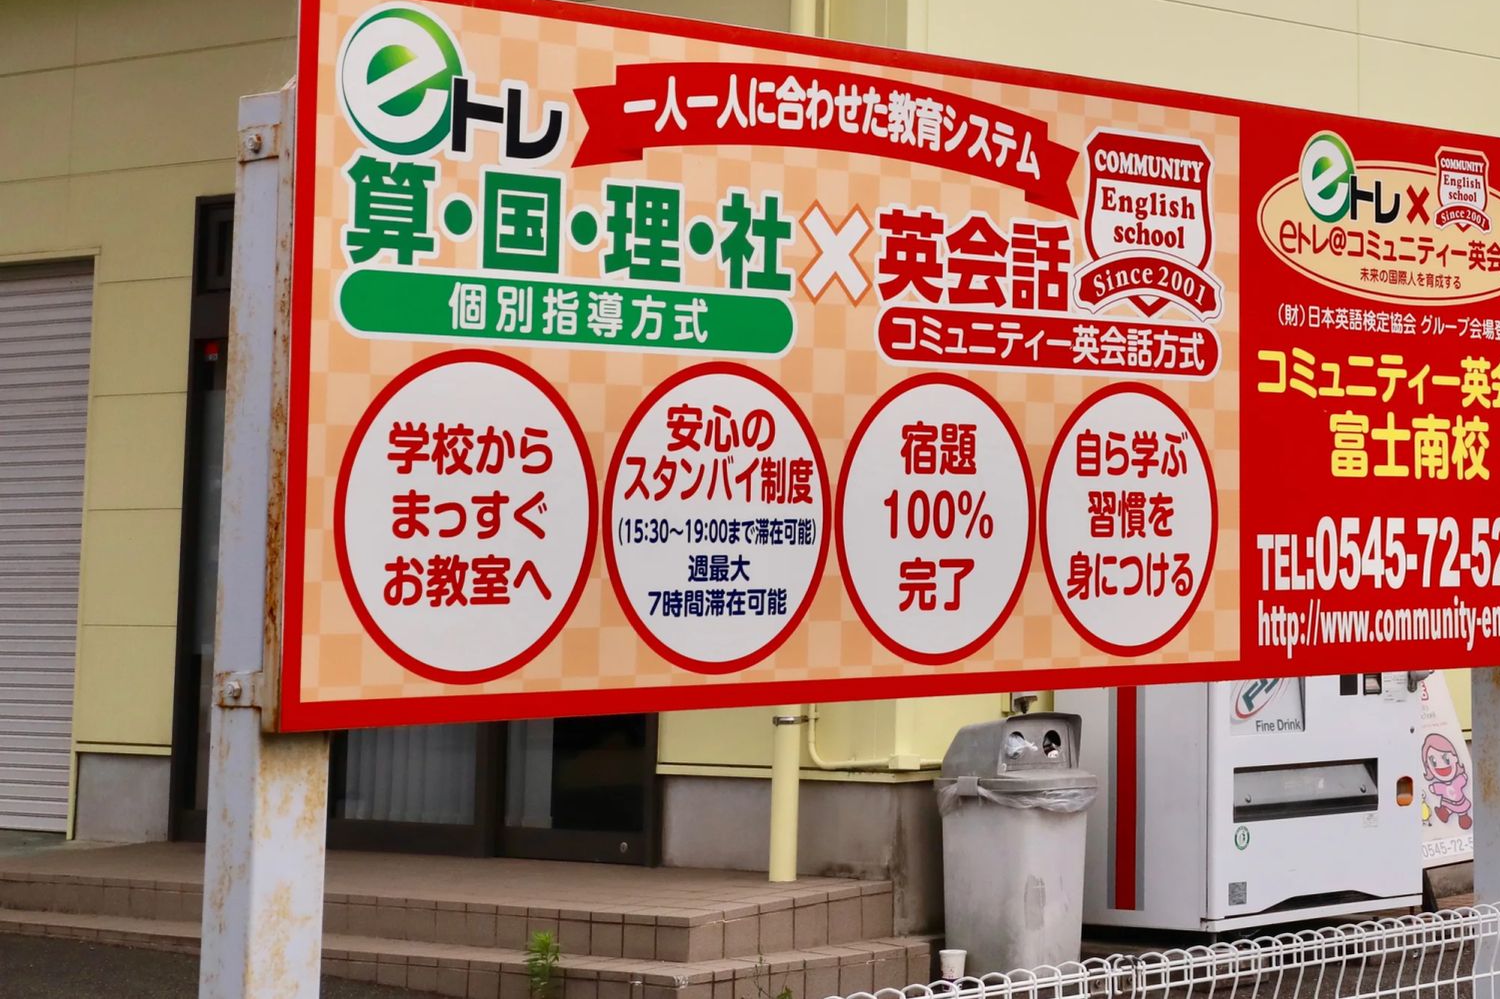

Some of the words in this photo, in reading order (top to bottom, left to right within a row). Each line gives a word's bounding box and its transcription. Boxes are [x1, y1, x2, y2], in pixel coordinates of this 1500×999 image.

[341, 6, 563, 160] eトレ
[624, 73, 1041, 180] 一人一人に合わせた教育システム
[1094, 148, 1204, 184] COMMUNITY
[1301, 134, 1401, 224] eトレ
[1440, 157, 1485, 173] COMMUNITY
[1443, 174, 1481, 190] English
[1101, 186, 1196, 221] English
[1440, 209, 1465, 224] Since
[1466, 209, 1487, 228] 2001
[1448, 190, 1477, 203] school
[879, 208, 1072, 311] 英会話
[1113, 221, 1185, 250] school
[1092, 264, 1153, 297] Since
[1157, 266, 1207, 307] 2001
[1359, 267, 1462, 290] 未来の国際人を育成する
[448, 281, 709, 343] 個別指導方式
[890, 314, 1205, 371] コミュニティー英会話方式
[386, 421, 553, 476] 学校から
[666, 403, 776, 453] 安心の
[900, 420, 977, 476] 宿題
[1329, 410, 1490, 480] 富士南校
[1075, 428, 1188, 479] 自ら学ぶ
[623, 455, 814, 505] スタンバイ制度
[391, 489, 548, 540] まっすぐ
[883, 489, 994, 540] 100%
[1086, 491, 1176, 539] 習慣を
[383, 553, 552, 608] お教室へ
[687, 554, 751, 583] 週最大
[898, 557, 976, 613] 完了
[1066, 551, 1194, 601] 身につける
[647, 588, 787, 618] 7時間滞在可能
[1256, 719, 1275, 732] Fine
[1276, 718, 1302, 732] Drink
